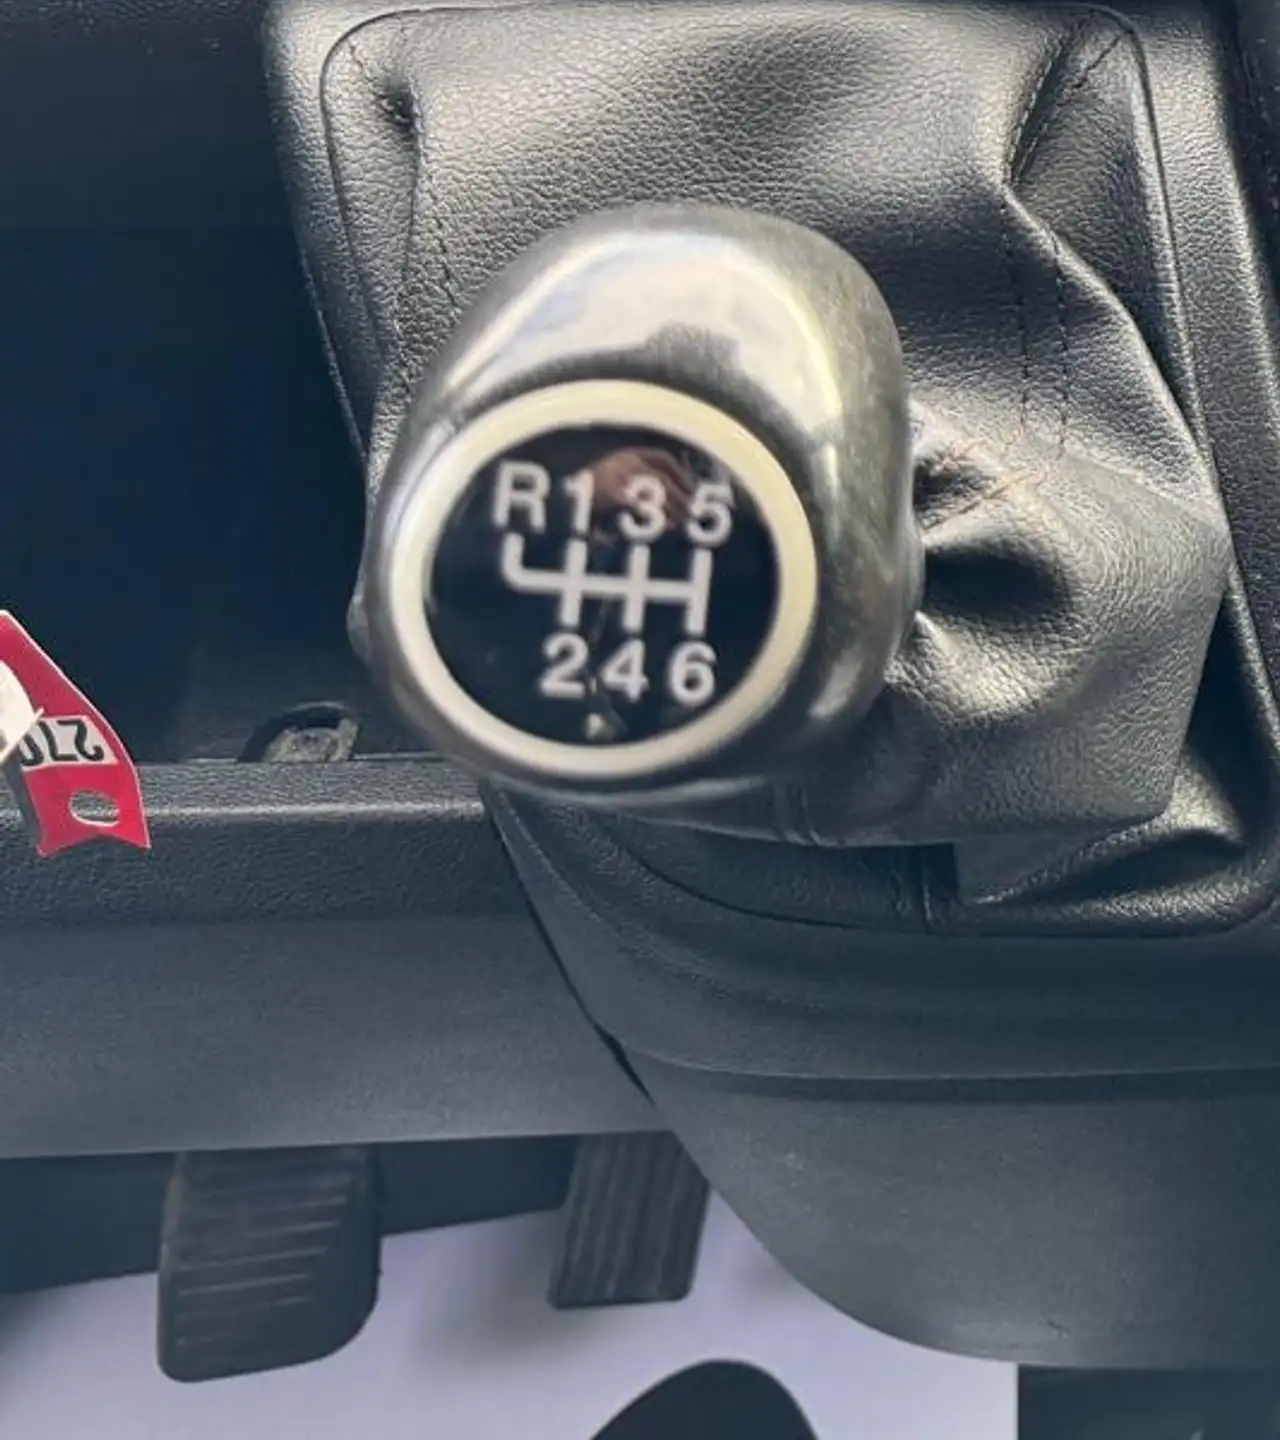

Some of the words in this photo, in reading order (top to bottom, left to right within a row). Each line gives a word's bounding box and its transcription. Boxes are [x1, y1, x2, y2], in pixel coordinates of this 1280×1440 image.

[493, 461, 551, 533] R
[563, 467, 595, 534] 1
[616, 473, 668, 544] 3
[685, 482, 735, 546] 5
[539, 632, 589, 699] 2
[602, 638, 650, 703] 4
[667, 641, 717, 708] 6
